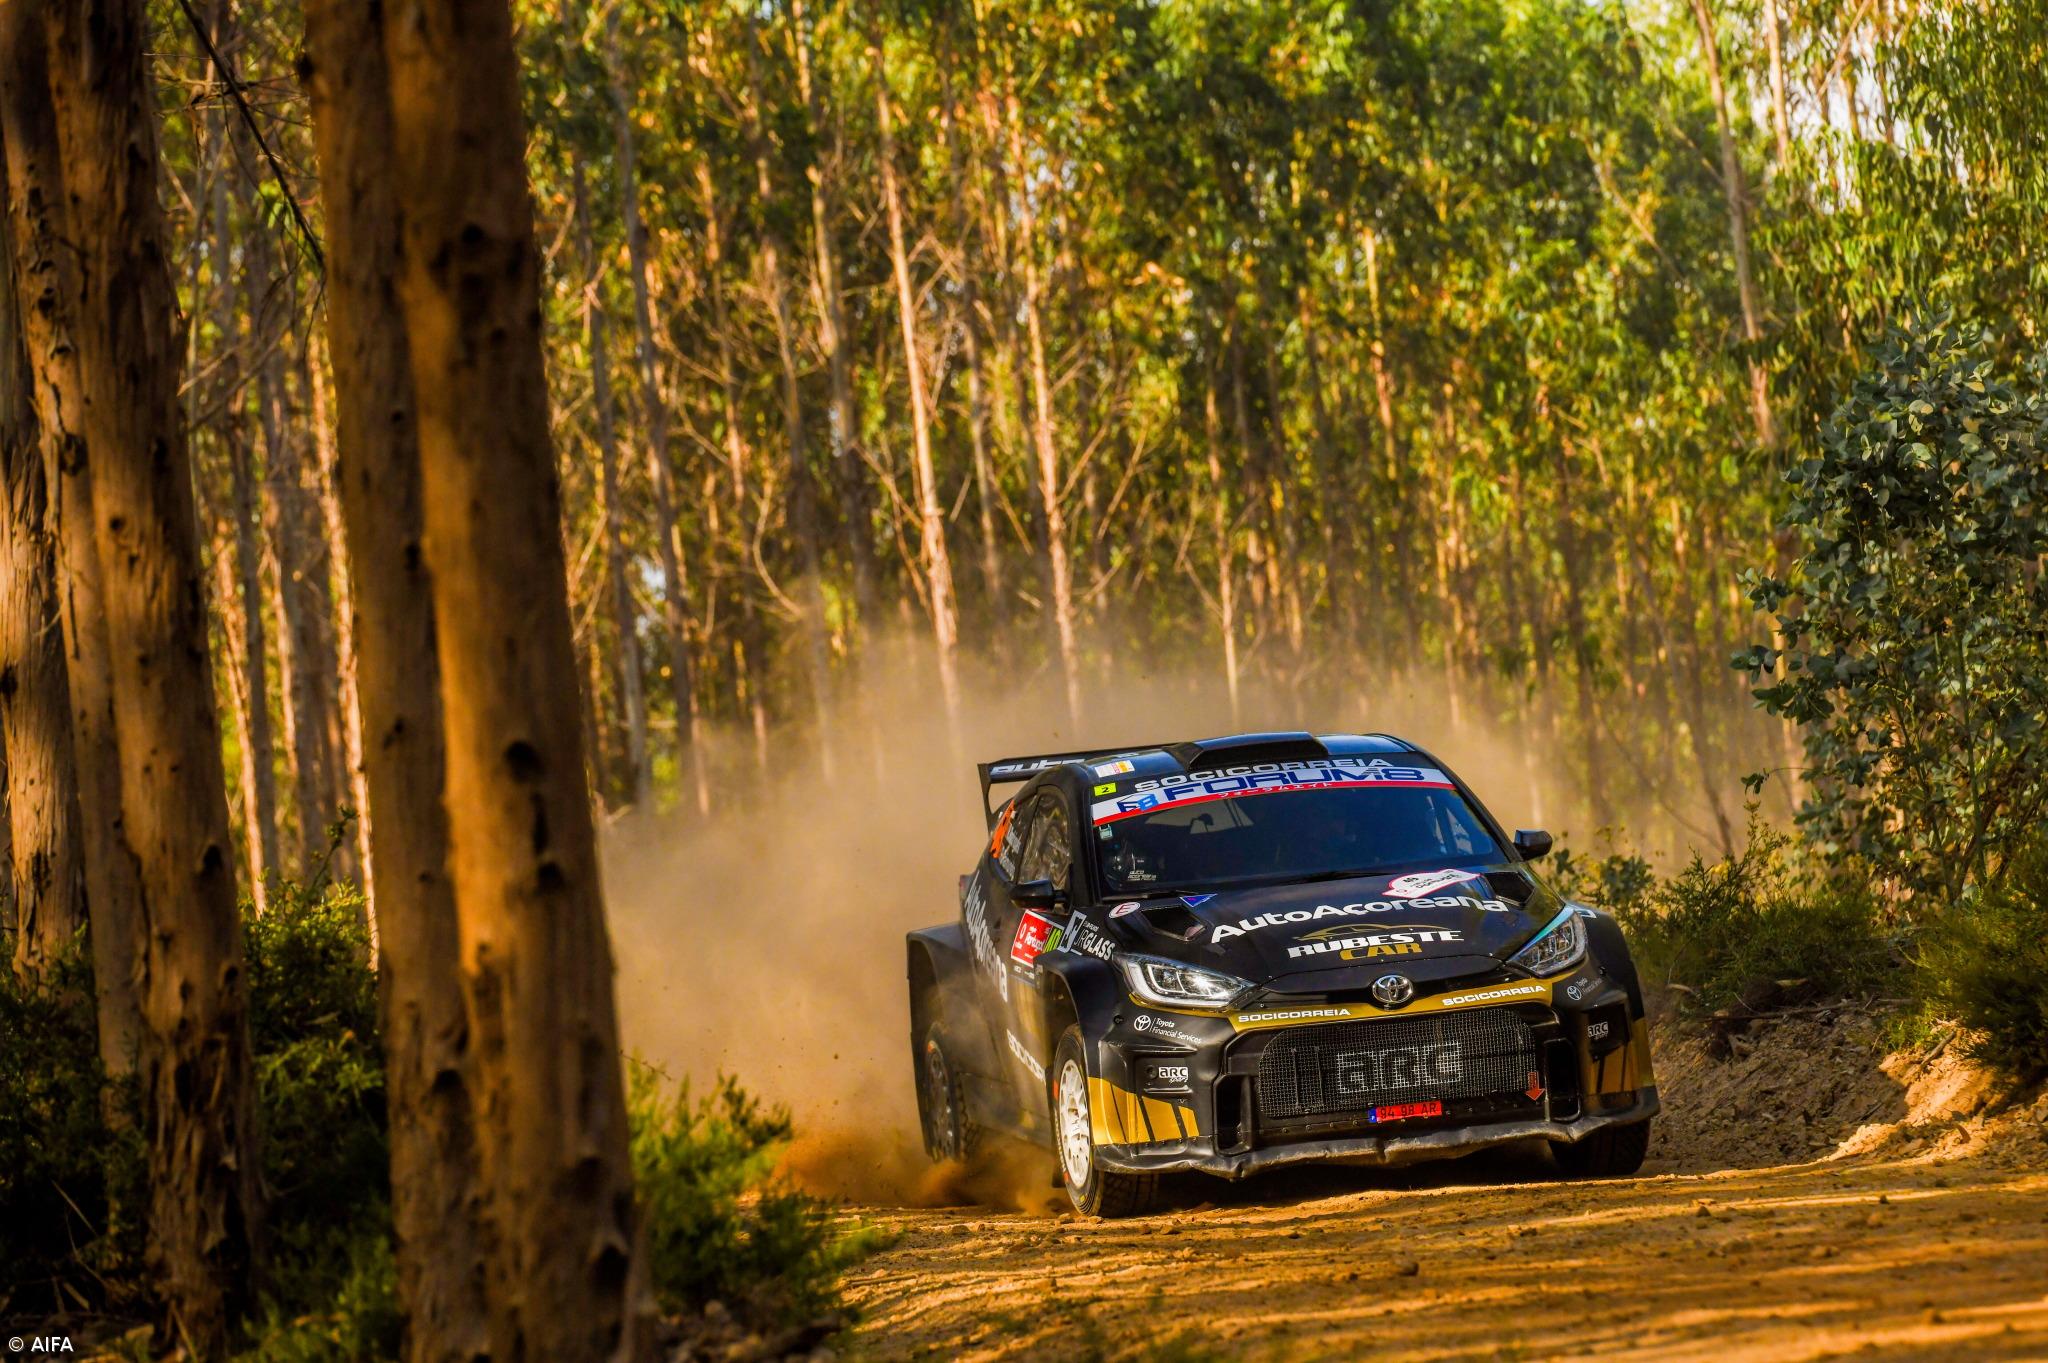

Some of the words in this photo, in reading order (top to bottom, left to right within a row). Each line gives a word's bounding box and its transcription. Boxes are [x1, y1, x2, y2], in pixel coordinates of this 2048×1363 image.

[1134, 758, 1395, 793] SOCICORREIA
[1163, 768, 1426, 801] FORUM8
[1101, 786, 1110, 794] 2
[1115, 904, 1136, 915] E
[1210, 895, 1509, 944] AutoAçoreana
[1286, 929, 1465, 959] RUBESTE
[1338, 942, 1424, 961] CAR
[1441, 984, 1547, 1007] SOCICORREIA
[1156, 1017, 1175, 1028] Toyota
[1237, 1008, 1352, 1024] SOCICORREIA
[1152, 1026, 1177, 1038] Financial
[1177, 1031, 1202, 1044] Services
[1379, 1107, 1395, 1118] 94
[1400, 1103, 1415, 1115] 98
[1420, 1102, 1438, 1115] AR
